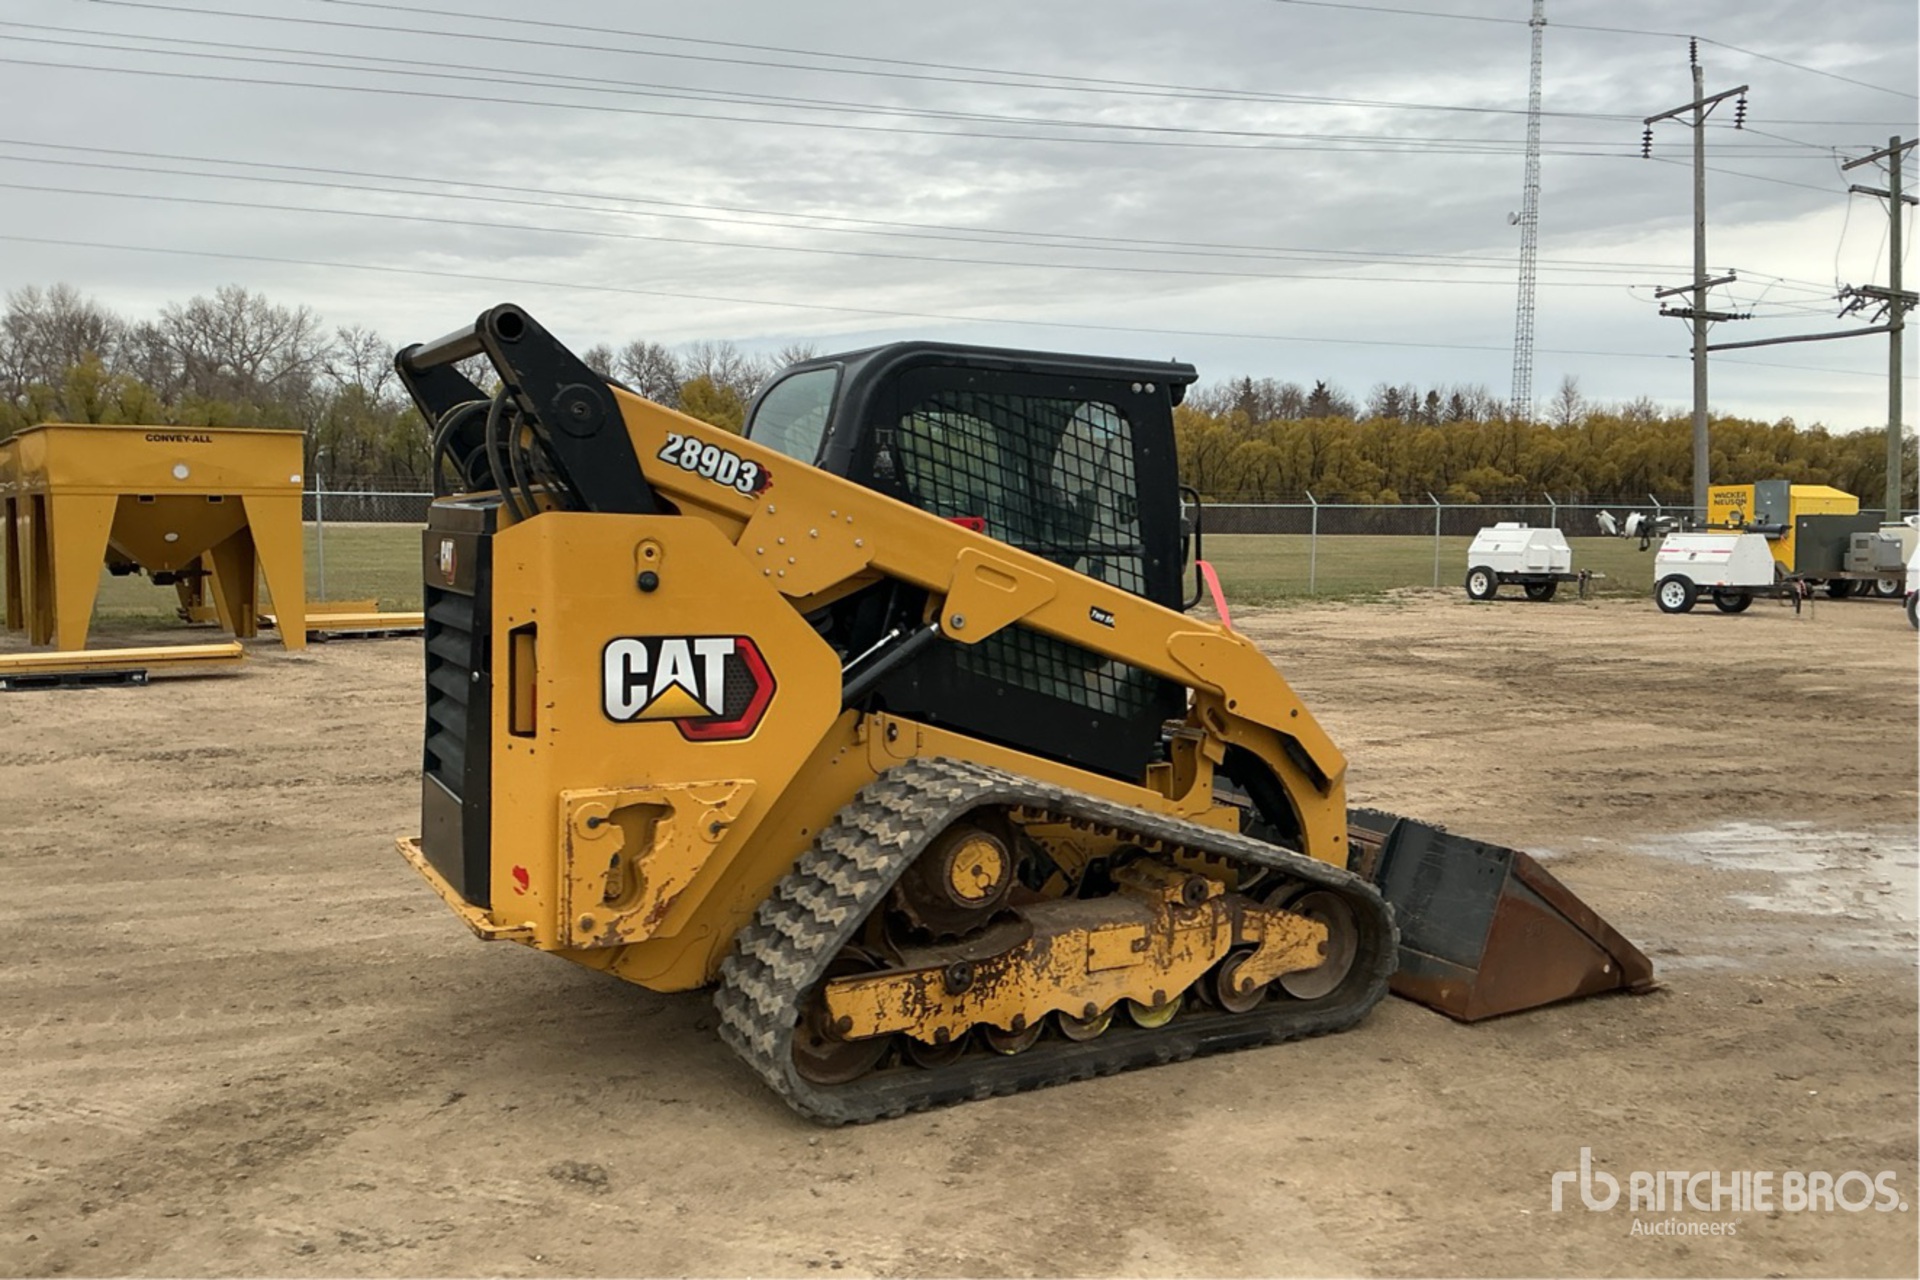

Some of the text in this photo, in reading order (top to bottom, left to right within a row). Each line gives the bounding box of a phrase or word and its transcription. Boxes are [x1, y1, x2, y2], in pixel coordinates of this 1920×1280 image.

[145, 433, 213, 444] CONVEY-ALL
[659, 432, 758, 493] 289D3
[1713, 491, 1747, 499] WACKER
[604, 638, 735, 720] CAT
